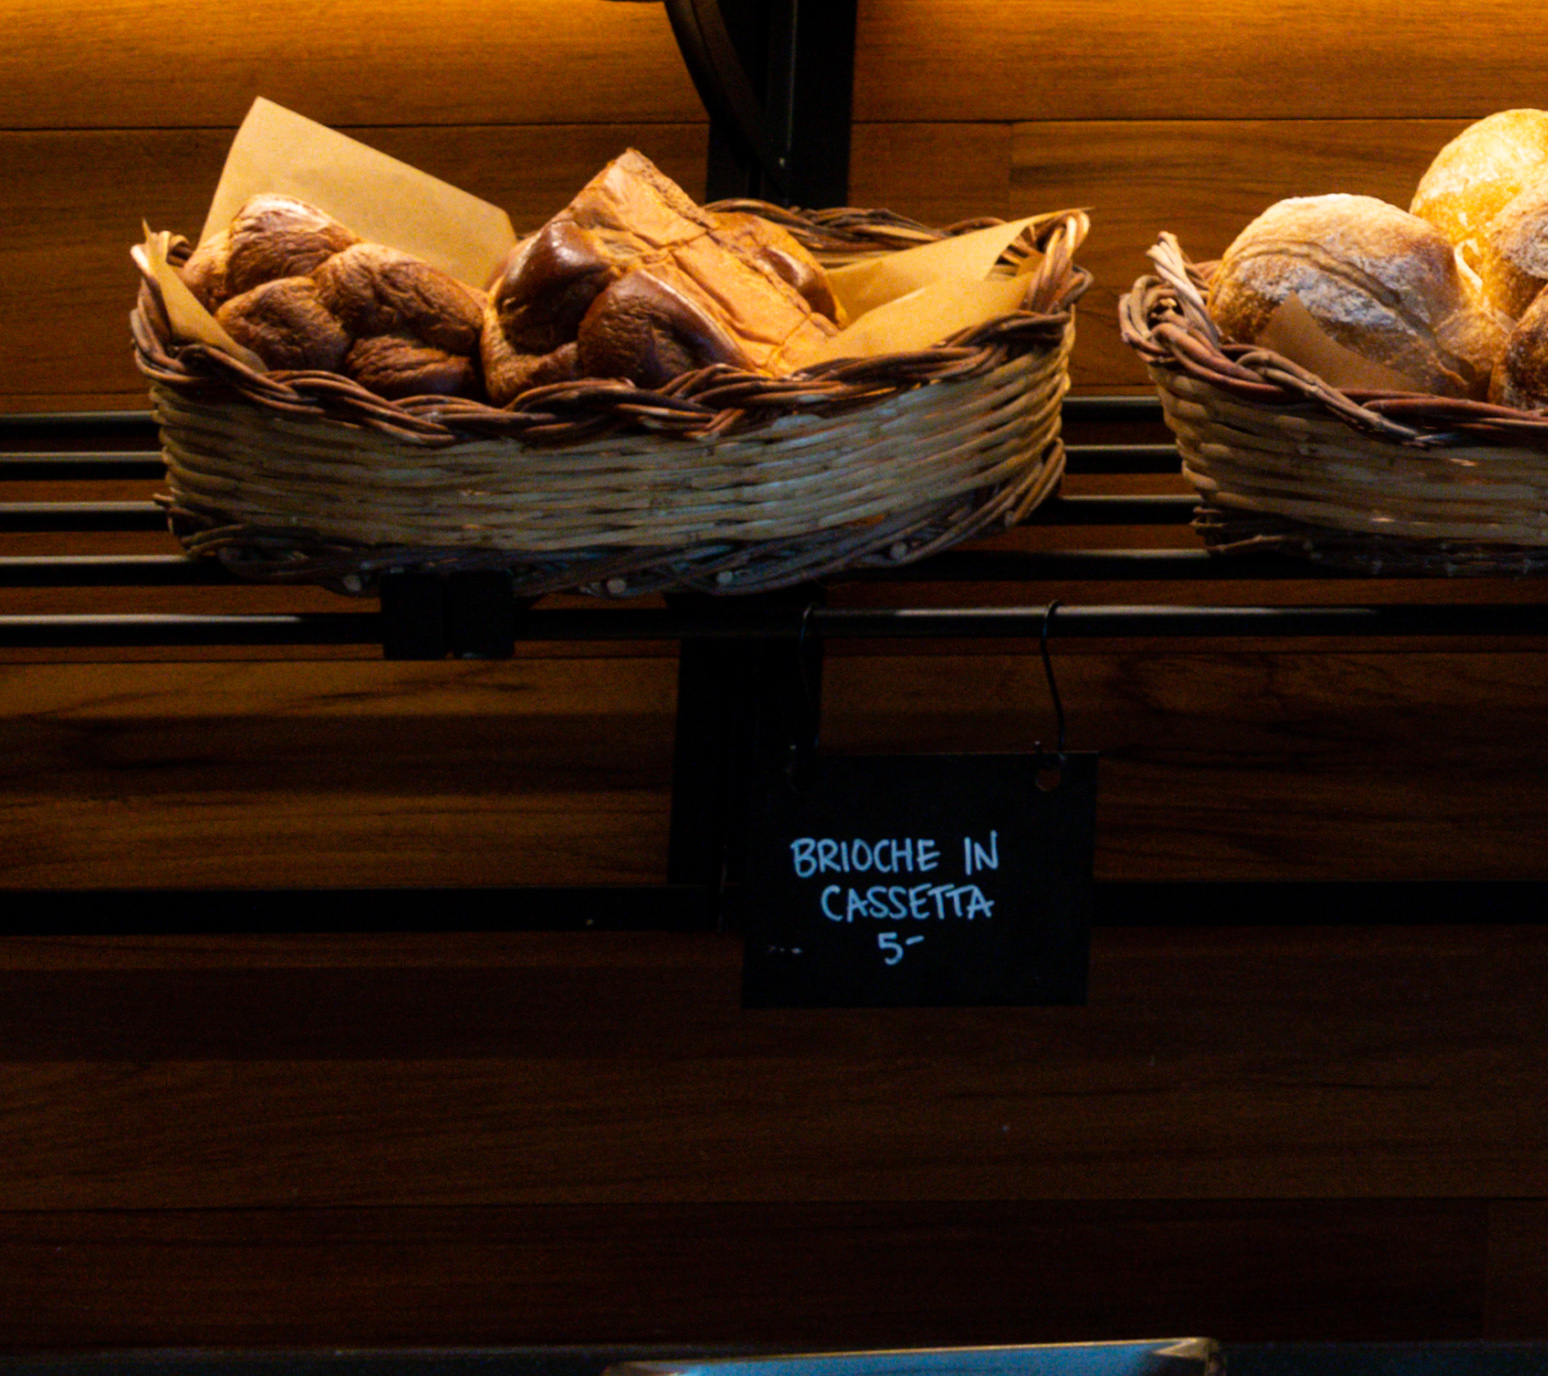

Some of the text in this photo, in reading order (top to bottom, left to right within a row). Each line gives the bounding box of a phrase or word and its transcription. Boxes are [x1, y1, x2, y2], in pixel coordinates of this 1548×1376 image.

[789, 828, 1000, 879] BRIOCHE IN
[820, 882, 996, 923] CASSETTA
